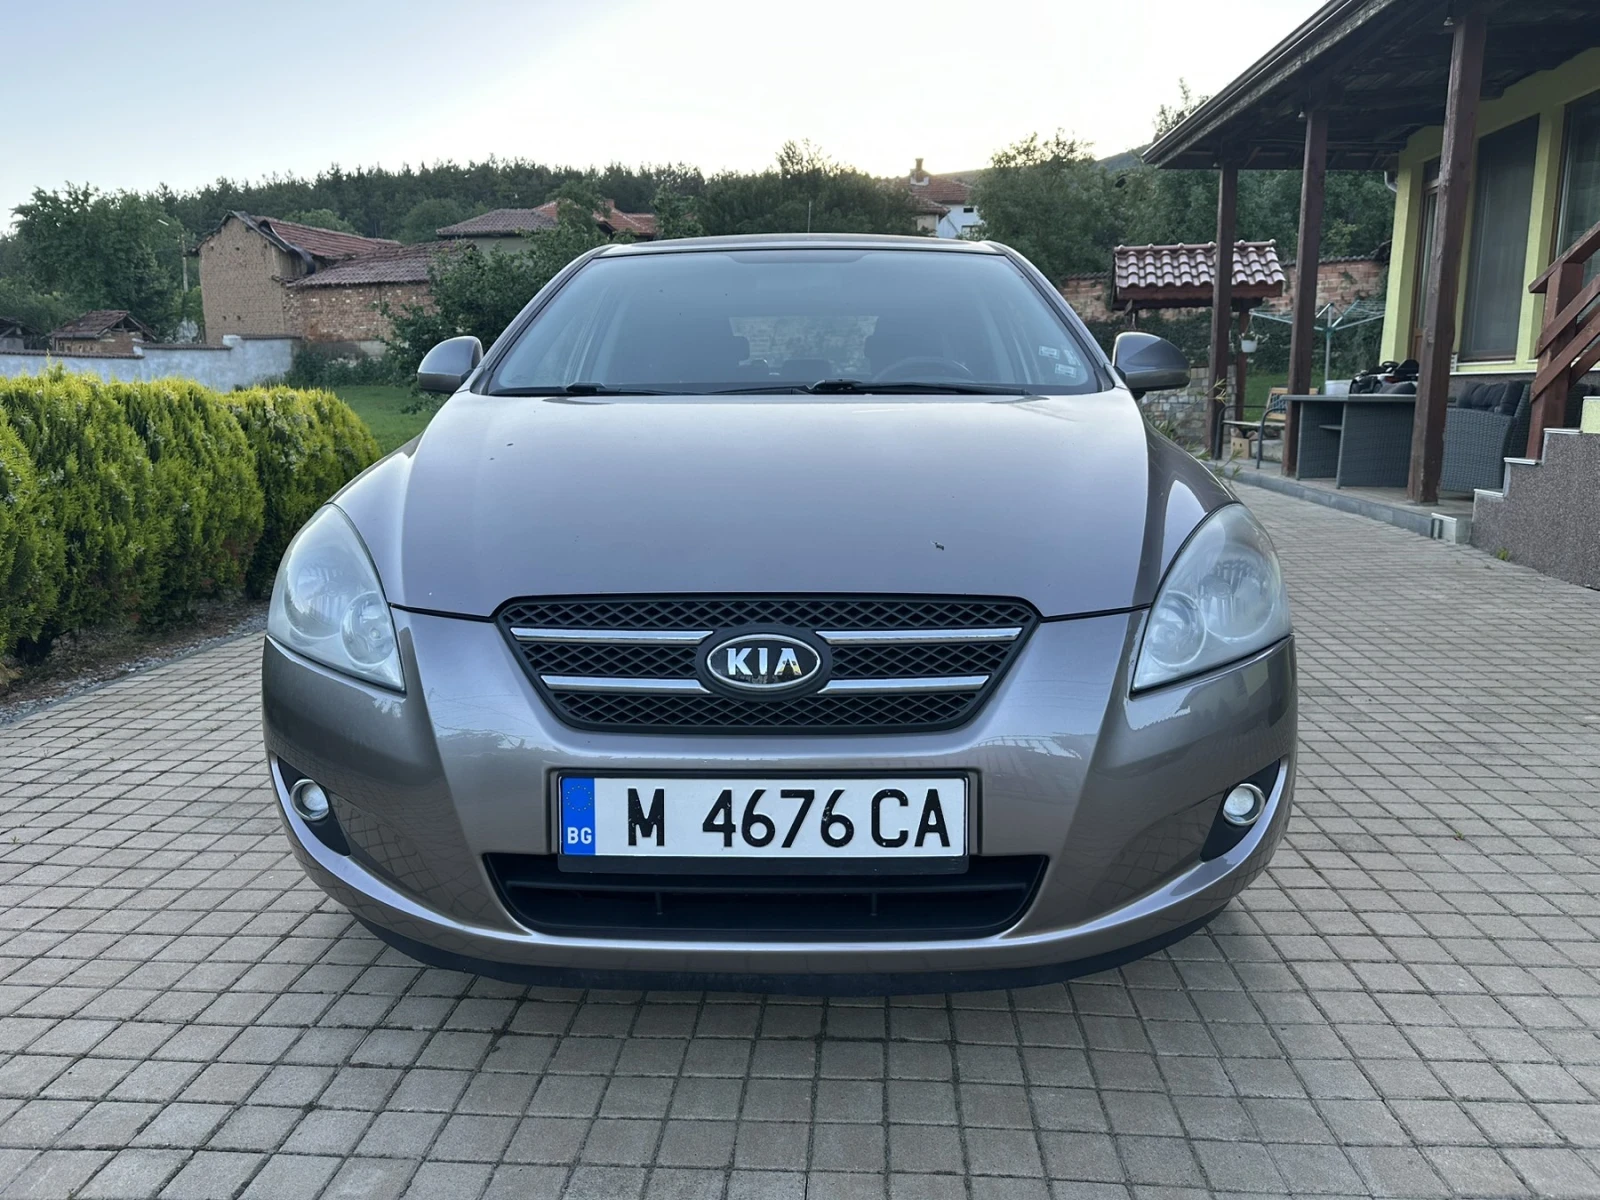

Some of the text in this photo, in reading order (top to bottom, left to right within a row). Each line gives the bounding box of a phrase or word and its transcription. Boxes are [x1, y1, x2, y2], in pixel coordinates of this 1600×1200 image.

[726, 647, 802, 676] KIA
[627, 788, 951, 848] M 4676 CA
[567, 827, 593, 844] BG
